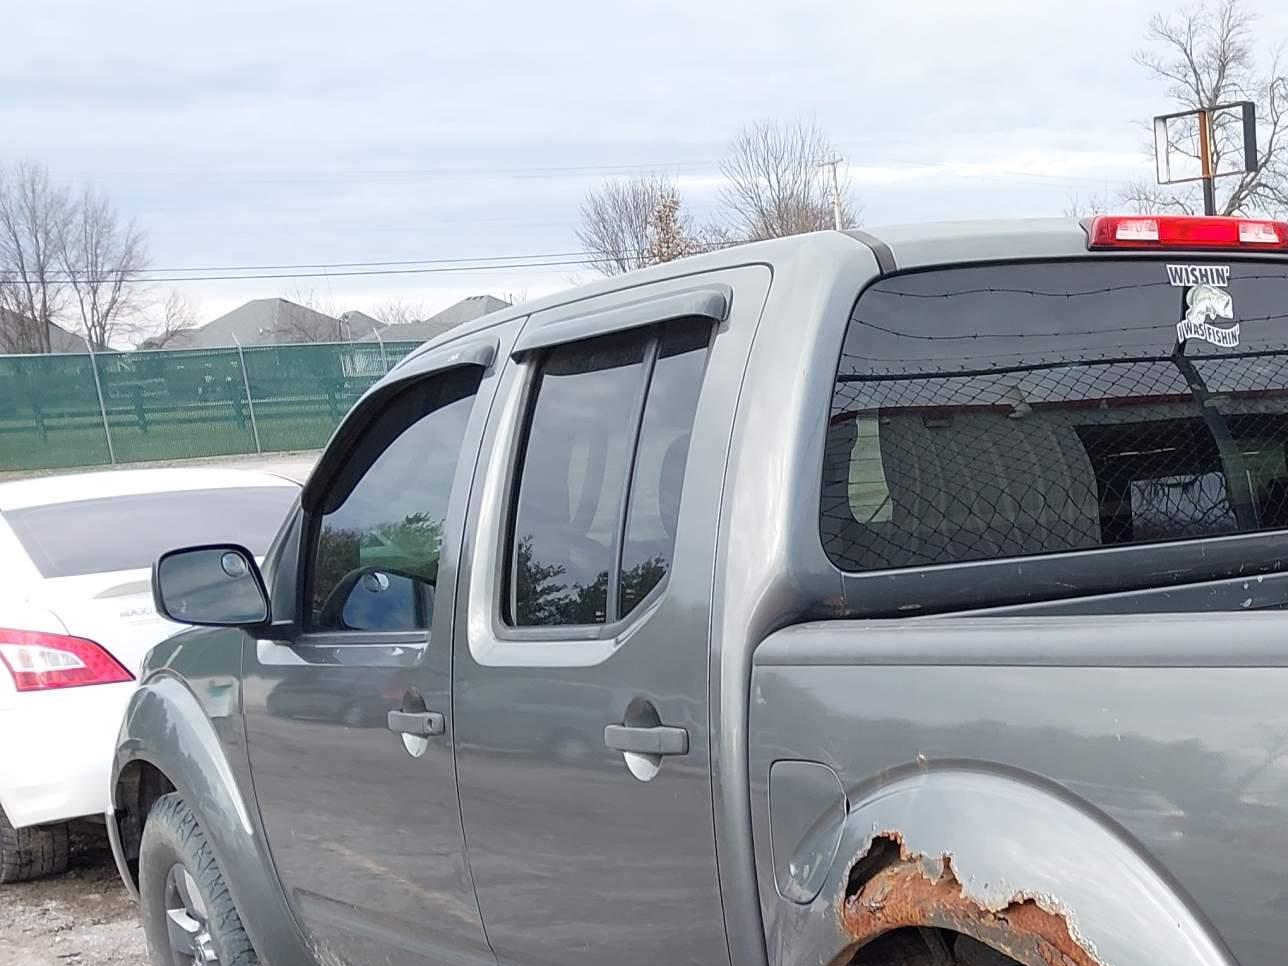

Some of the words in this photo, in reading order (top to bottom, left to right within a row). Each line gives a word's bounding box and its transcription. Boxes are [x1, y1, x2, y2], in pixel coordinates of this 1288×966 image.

[1166, 264, 1230, 287] WISHIN'
[1177, 322, 1185, 344] I
[1183, 321, 1206, 339] WAS
[1205, 323, 1240, 347] FISHIN'
